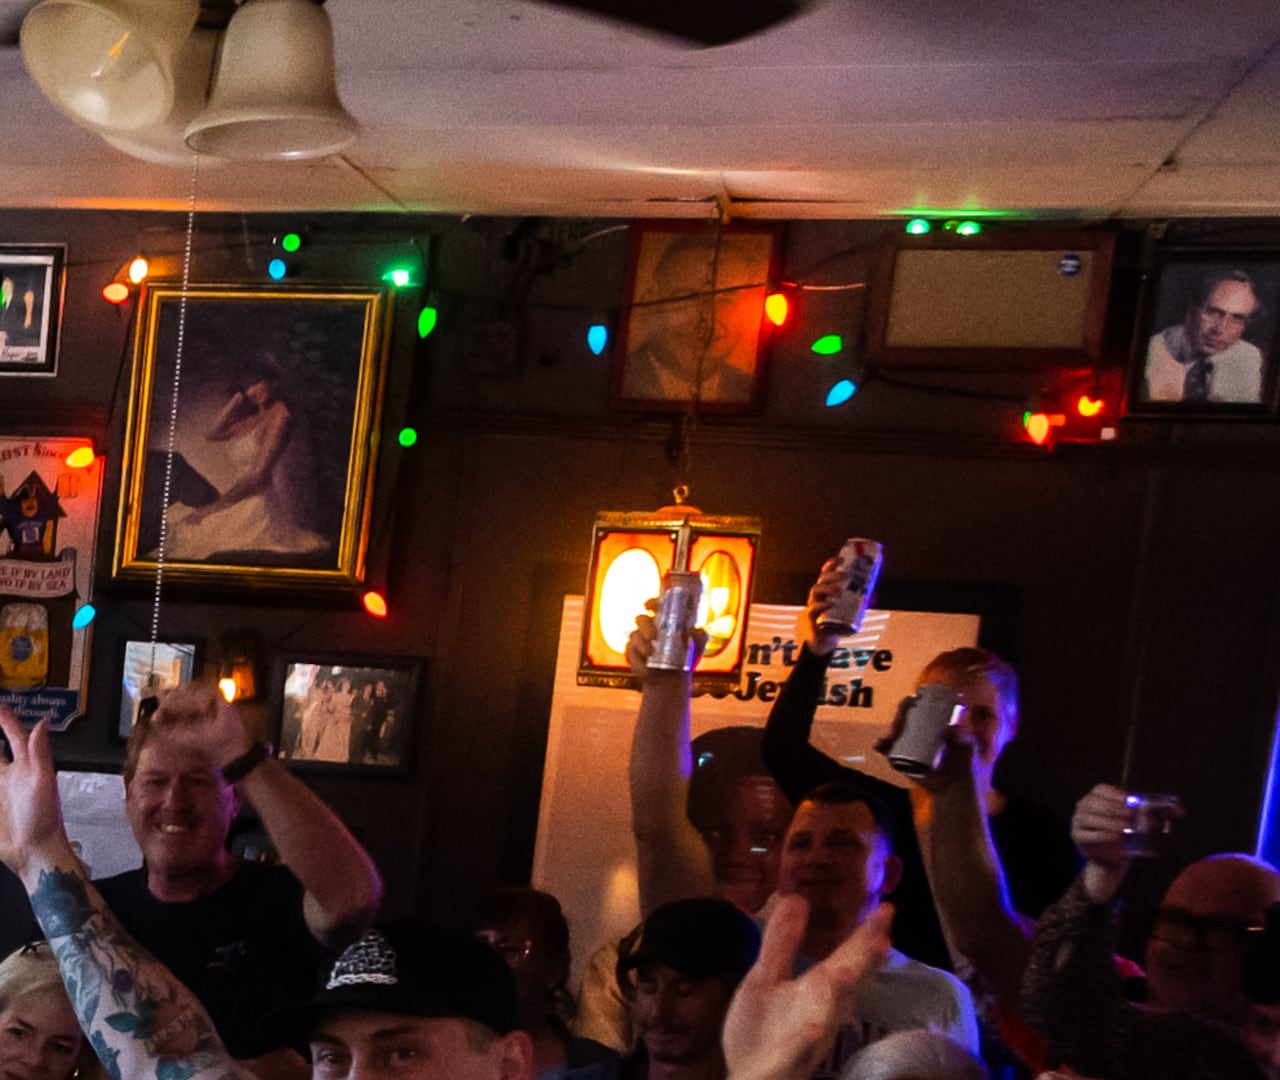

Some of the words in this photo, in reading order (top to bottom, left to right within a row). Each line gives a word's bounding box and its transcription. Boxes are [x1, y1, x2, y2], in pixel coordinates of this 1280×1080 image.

[11, 567, 23, 578] IF
[23, 568, 38, 579] BY
[41, 567, 71, 580] LAND
[15, 579, 26, 590] IF
[26, 579, 42, 591] BY
[46, 579, 67, 591] SEA
[828, 646, 894, 672] ave
